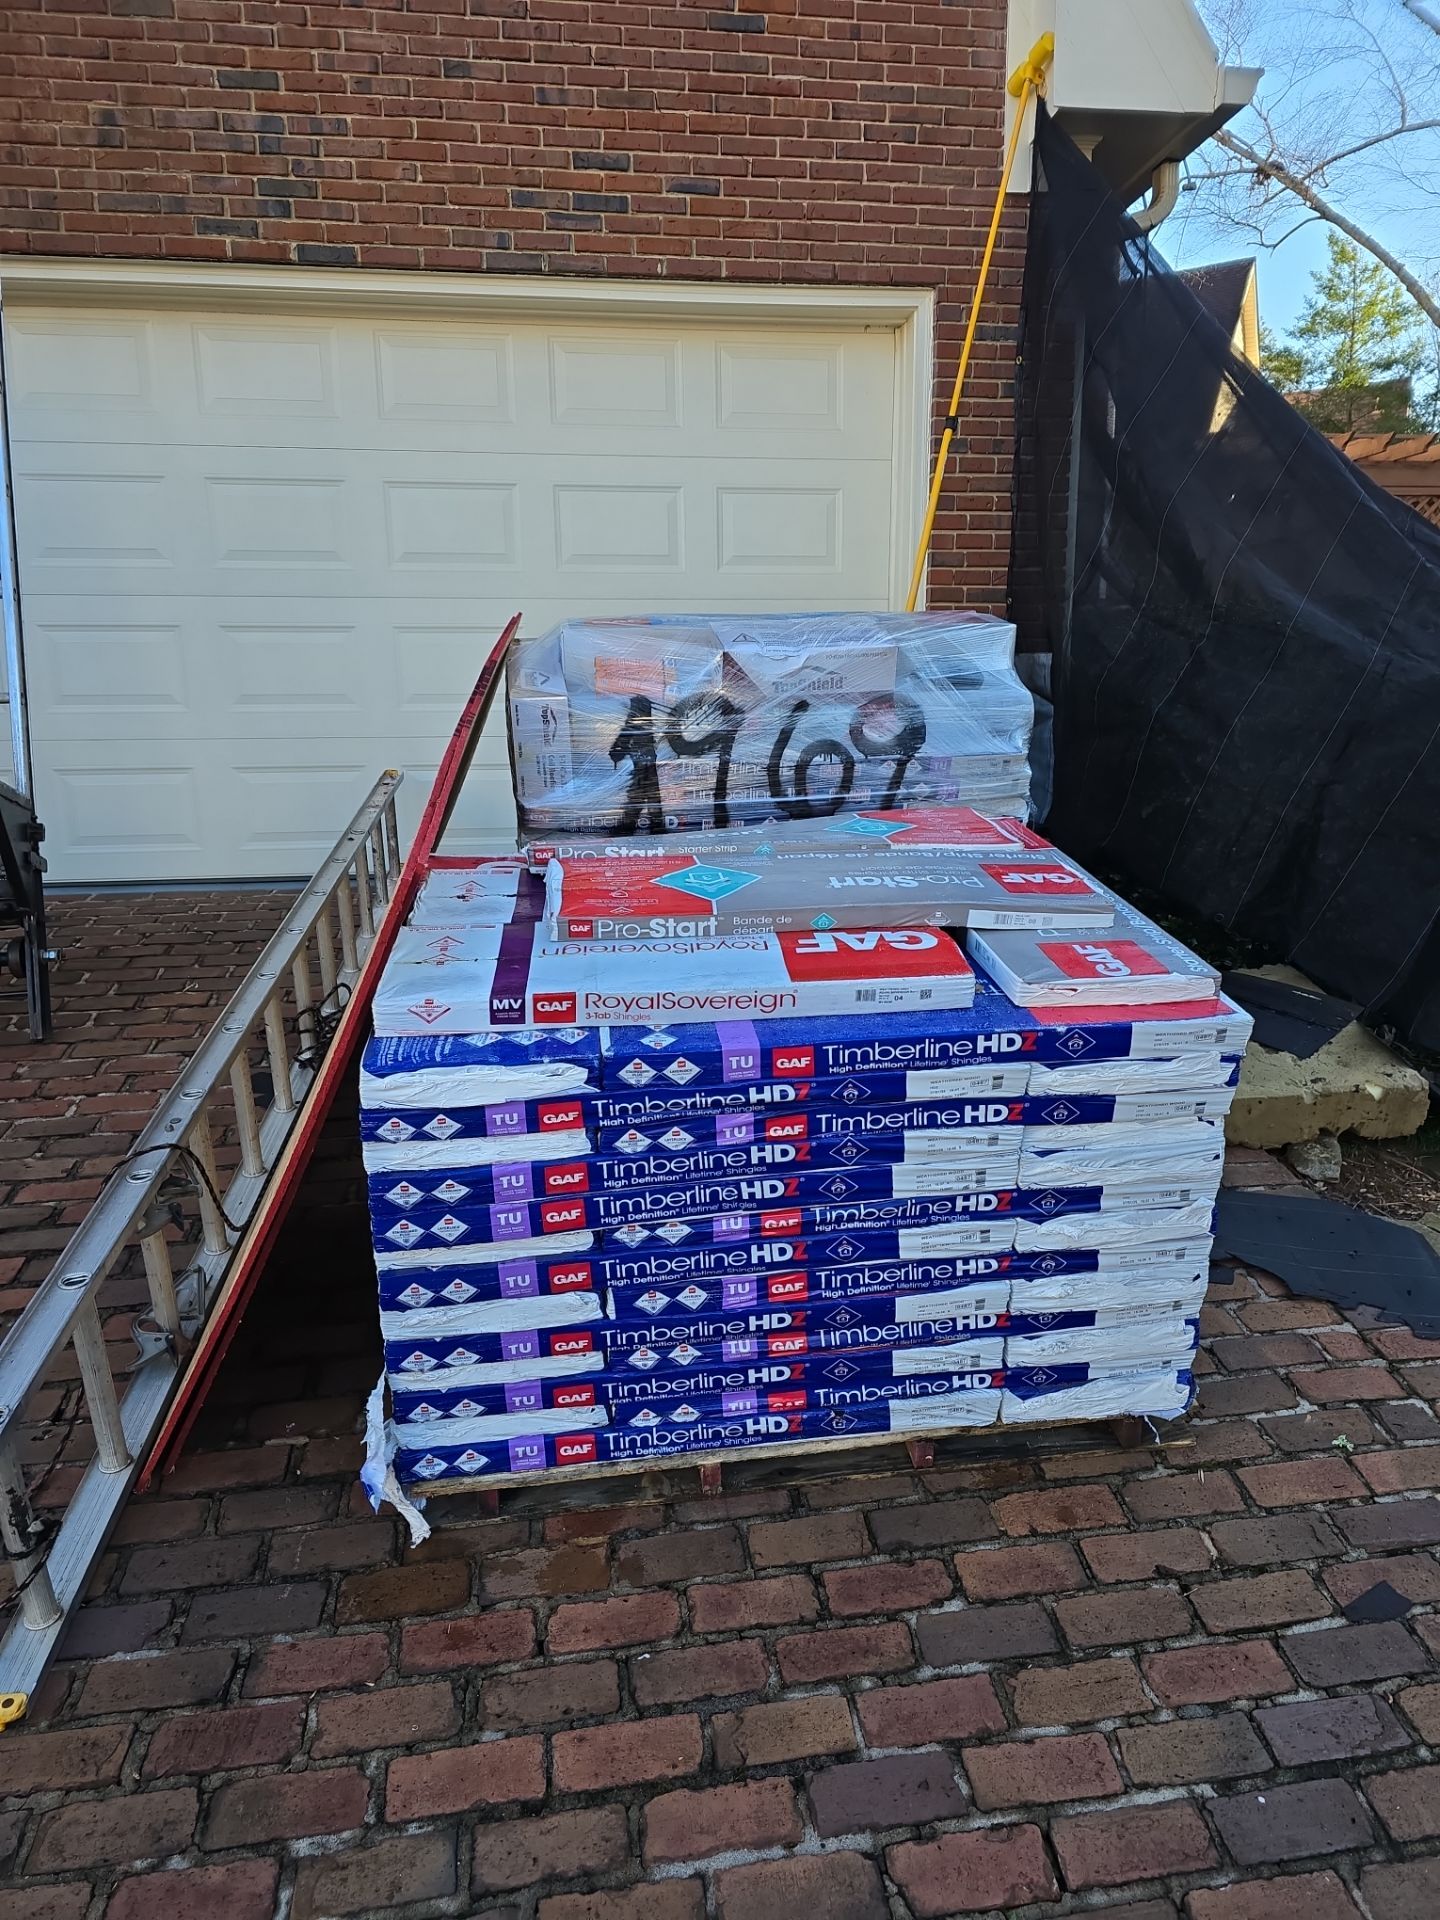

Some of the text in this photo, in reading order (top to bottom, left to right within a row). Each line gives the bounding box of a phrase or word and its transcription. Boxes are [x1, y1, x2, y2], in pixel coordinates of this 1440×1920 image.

[679, 845, 713, 854] Starter
[715, 844, 738, 854] Strip
[829, 875, 984, 889] Pro-Start
[1002, 873, 1078, 885] GAF
[570, 915, 792, 939] GAF Pro-Start Bande de
[733, 926, 775, 935] départ
[541, 939, 769, 957] RoyalSovereign
[796, 931, 938, 953] GAF
[1072, 944, 1131, 976] GAF
[492, 999, 522, 1010] MV
[537, 991, 796, 1013] GAF RoyalSovereign
[585, 1012, 650, 1022] 3-Tab Shingles
[776, 1031, 1037, 1068] GAF Timberline HDZ
[729, 1055, 754, 1070] TU
[829, 1056, 992, 1074] High Definition Lifetime Shingles
[543, 1082, 810, 1124] GAF Timberline HDZ
[492, 1112, 519, 1126] TU
[770, 1125, 804, 1136] GAF
[816, 1107, 960, 1133] Timberline
[964, 1103, 1024, 1124] HDZ
[723, 1126, 746, 1138] TU
[549, 1143, 811, 1185] GAF Timberline HDZ
[500, 1175, 525, 1188] TU
[604, 1166, 767, 1188] High Definition Lifetime Shingles
[546, 1178, 799, 1222] GAF Timberline HDZ
[810, 1199, 952, 1224] Timberline
[955, 1192, 1012, 1212] HDZ
[497, 1211, 521, 1225] TU
[601, 1215, 625, 1225] High
[628, 1209, 676, 1221] Definition
[681, 1204, 719, 1215] Lifetime
[815, 1214, 970, 1232] High Definition Lifetime Shingles
[553, 1242, 808, 1284] GAF Timberline HDZ
[506, 1274, 530, 1288] TU
[607, 1279, 630, 1287] High
[633, 1274, 680, 1284] Definition
[771, 1282, 805, 1294] GAF
[816, 1263, 953, 1289] Timberline
[727, 1282, 750, 1294] TU
[822, 1290, 844, 1298] High
[847, 1284, 892, 1295] Definition
[896, 1281, 930, 1289] Lifetime
[555, 1312, 806, 1351] GAF Timberline HDZ
[772, 1339, 804, 1351] GAF
[814, 1320, 953, 1347] Timberline
[508, 1342, 532, 1354] TU
[728, 1339, 751, 1354] TU
[558, 1364, 805, 1403] GAF Timberline HDZ
[512, 1395, 535, 1406] TU
[560, 1414, 803, 1456] GAF Timberline HDZ
[515, 1446, 538, 1457] TU
[610, 1436, 762, 1458] High Definition Lifetime Shingles
